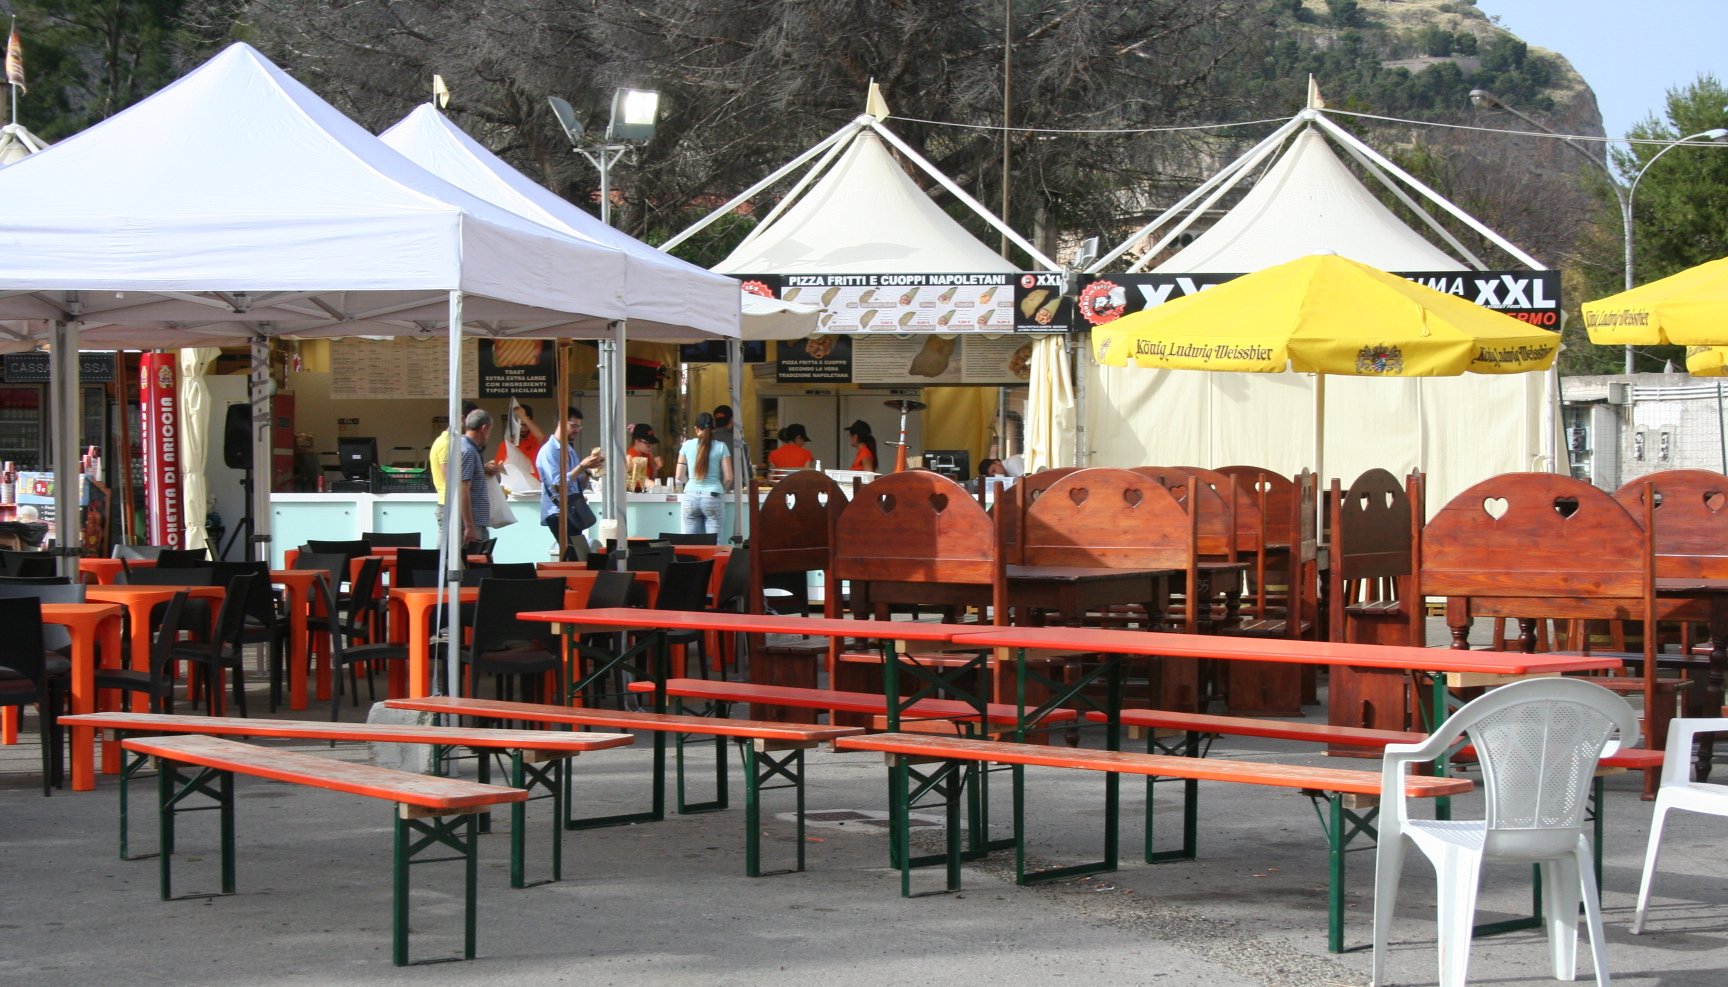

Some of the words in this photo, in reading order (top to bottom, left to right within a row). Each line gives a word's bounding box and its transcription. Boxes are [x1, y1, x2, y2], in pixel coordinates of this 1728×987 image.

[789, 276, 824, 286] PIZZA
[827, 276, 867, 286] FRITTI
[870, 276, 878, 285] E
[880, 275, 926, 285] CUOPPI
[929, 275, 1006, 285] NAPOLETANI
[1036, 274, 1063, 286] XXL
[1474, 275, 1556, 308] XXL
[1135, 338, 1167, 361] König
[1165, 342, 1213, 363] Ludwig
[1214, 345, 1273, 361] Weissbier
[160, 397, 175, 462] ARICCIA
[164, 466, 176, 484] DI
[165, 488, 179, 550] CHETTA
